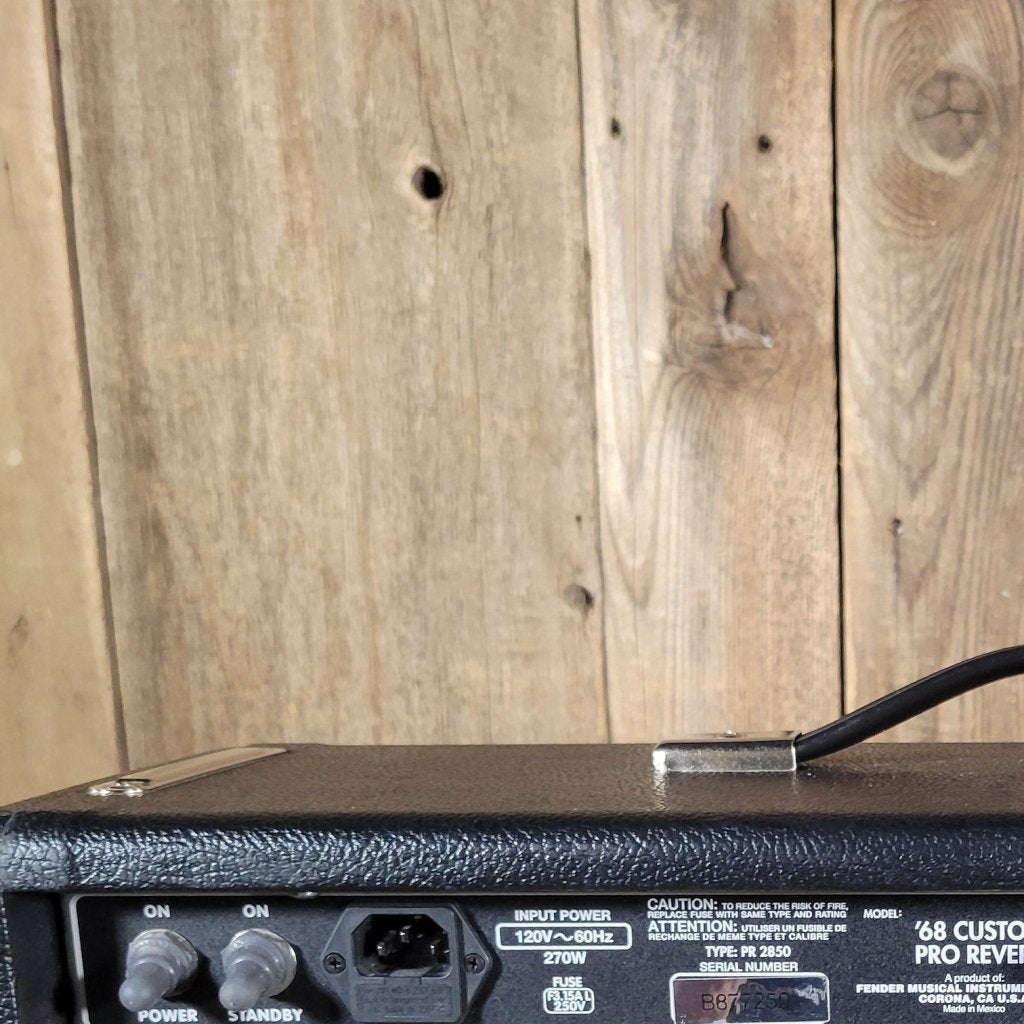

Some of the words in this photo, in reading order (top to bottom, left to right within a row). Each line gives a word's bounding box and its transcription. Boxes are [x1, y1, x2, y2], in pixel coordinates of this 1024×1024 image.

[647, 898, 718, 911] CAUTION:
[722, 902, 734, 911] TO
[735, 902, 771, 911] REDUCE
[773, 902, 790, 911] THE
[791, 902, 811, 911] RISK
[813, 902, 825, 911] OF
[827, 902, 849, 911] FIRE,
[143, 905, 170, 919] ON
[242, 904, 269, 918] ON
[514, 910, 555, 922] INPUT
[559, 910, 612, 922] POWER
[647, 911, 687, 919] REPLACE
[690, 911, 713, 919] FUSE
[715, 911, 738, 919] WITH
[741, 911, 766, 919] SAME
[769, 911, 791, 919] TYPE
[794, 911, 812, 919] AND
[815, 911, 847, 919] RATING
[863, 909, 902, 919] MODEL:
[648, 921, 738, 933] ATTENTION:
[741, 924, 780, 933] UTILISER
[782, 924, 795, 933] UN
[796, 924, 833, 933] FUSIBLE
[834, 924, 847, 933] DE
[914, 920, 946, 941] '68
[648, 932, 700, 941] RECHANGE
[702, 932, 715, 941] DE
[717, 932, 746, 941] MEME
[749, 932, 772, 941] TYPE
[774, 932, 785, 941] ET
[789, 932, 829, 941] CALIBRE
[706, 946, 737, 958] TYPE:
[741, 946, 756, 958] PR
[760, 946, 791, 958] 2850
[543, 952, 587, 965] 270W
[699, 962, 739, 972] SERIAL
[745, 962, 798, 972] NUMBER
[552, 977, 583, 988] FUSE
[944, 973, 952, 984] A
[953, 973, 990, 984] product
[992, 973, 1005, 984] of:
[856, 984, 904, 995] FENDER
[907, 984, 961, 995] MUSICAL
[547, 990, 583, 1002] F3.15A
[919, 994, 974, 1005] CORONA,
[977, 994, 994, 1005] CA
[553, 1001, 586, 1012] 250V
[943, 1004, 966, 1014] Made
[967, 1004, 975, 1014] in
[976, 1004, 1005, 1014] Mexico
[138, 1009, 198, 1023] POWER
[228, 1009, 303, 1023] STANDBY
